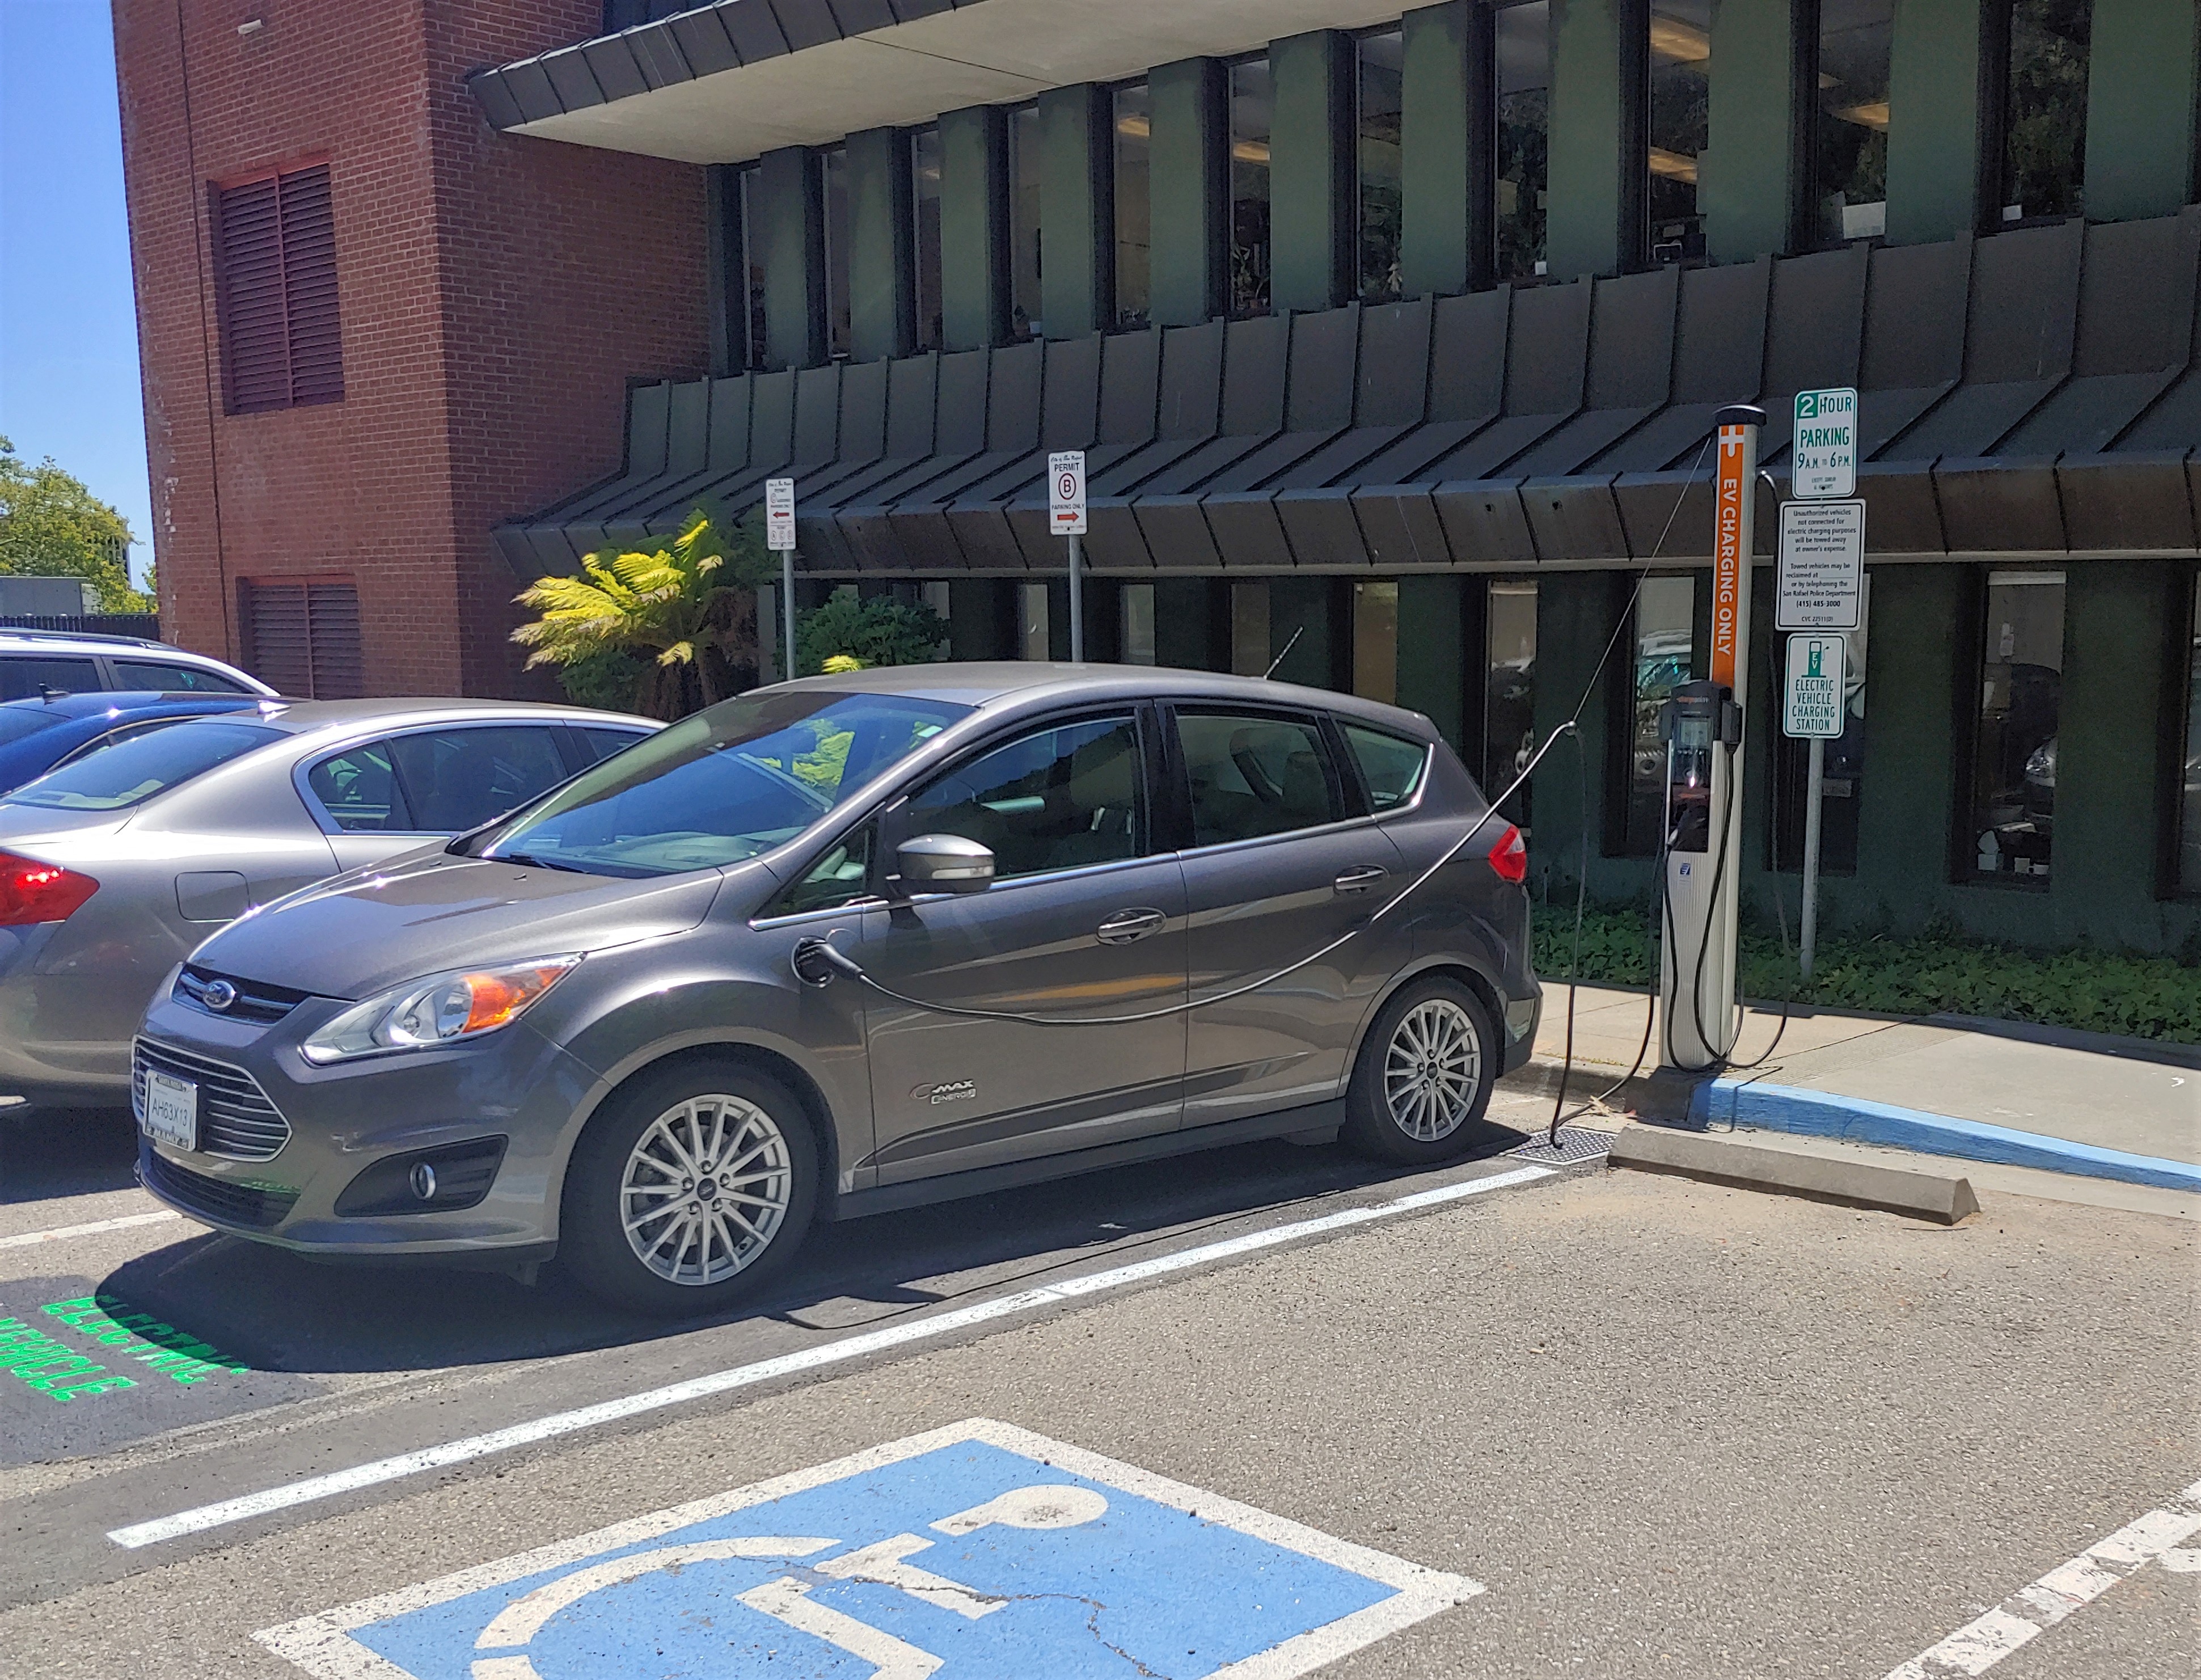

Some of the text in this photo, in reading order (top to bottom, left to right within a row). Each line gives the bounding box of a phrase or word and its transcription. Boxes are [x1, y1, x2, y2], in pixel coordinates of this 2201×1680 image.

[1800, 395, 1852, 416] 2 HOUR
[1800, 427, 1849, 448] PARKING
[1054, 463, 1080, 472] PERMIT
[1063, 479, 1071, 493] B
[1717, 478, 1737, 656] EV CHARGING ONLY
[1811, 652, 1818, 669] EV
[1796, 679, 1834, 691] ELECTRIC
[1797, 693, 1831, 704] VEHICLE
[1792, 706, 1835, 718] CHARGING
[1796, 719, 1830, 731] STATION
[41, 1294, 251, 1384] ELECTRIC
